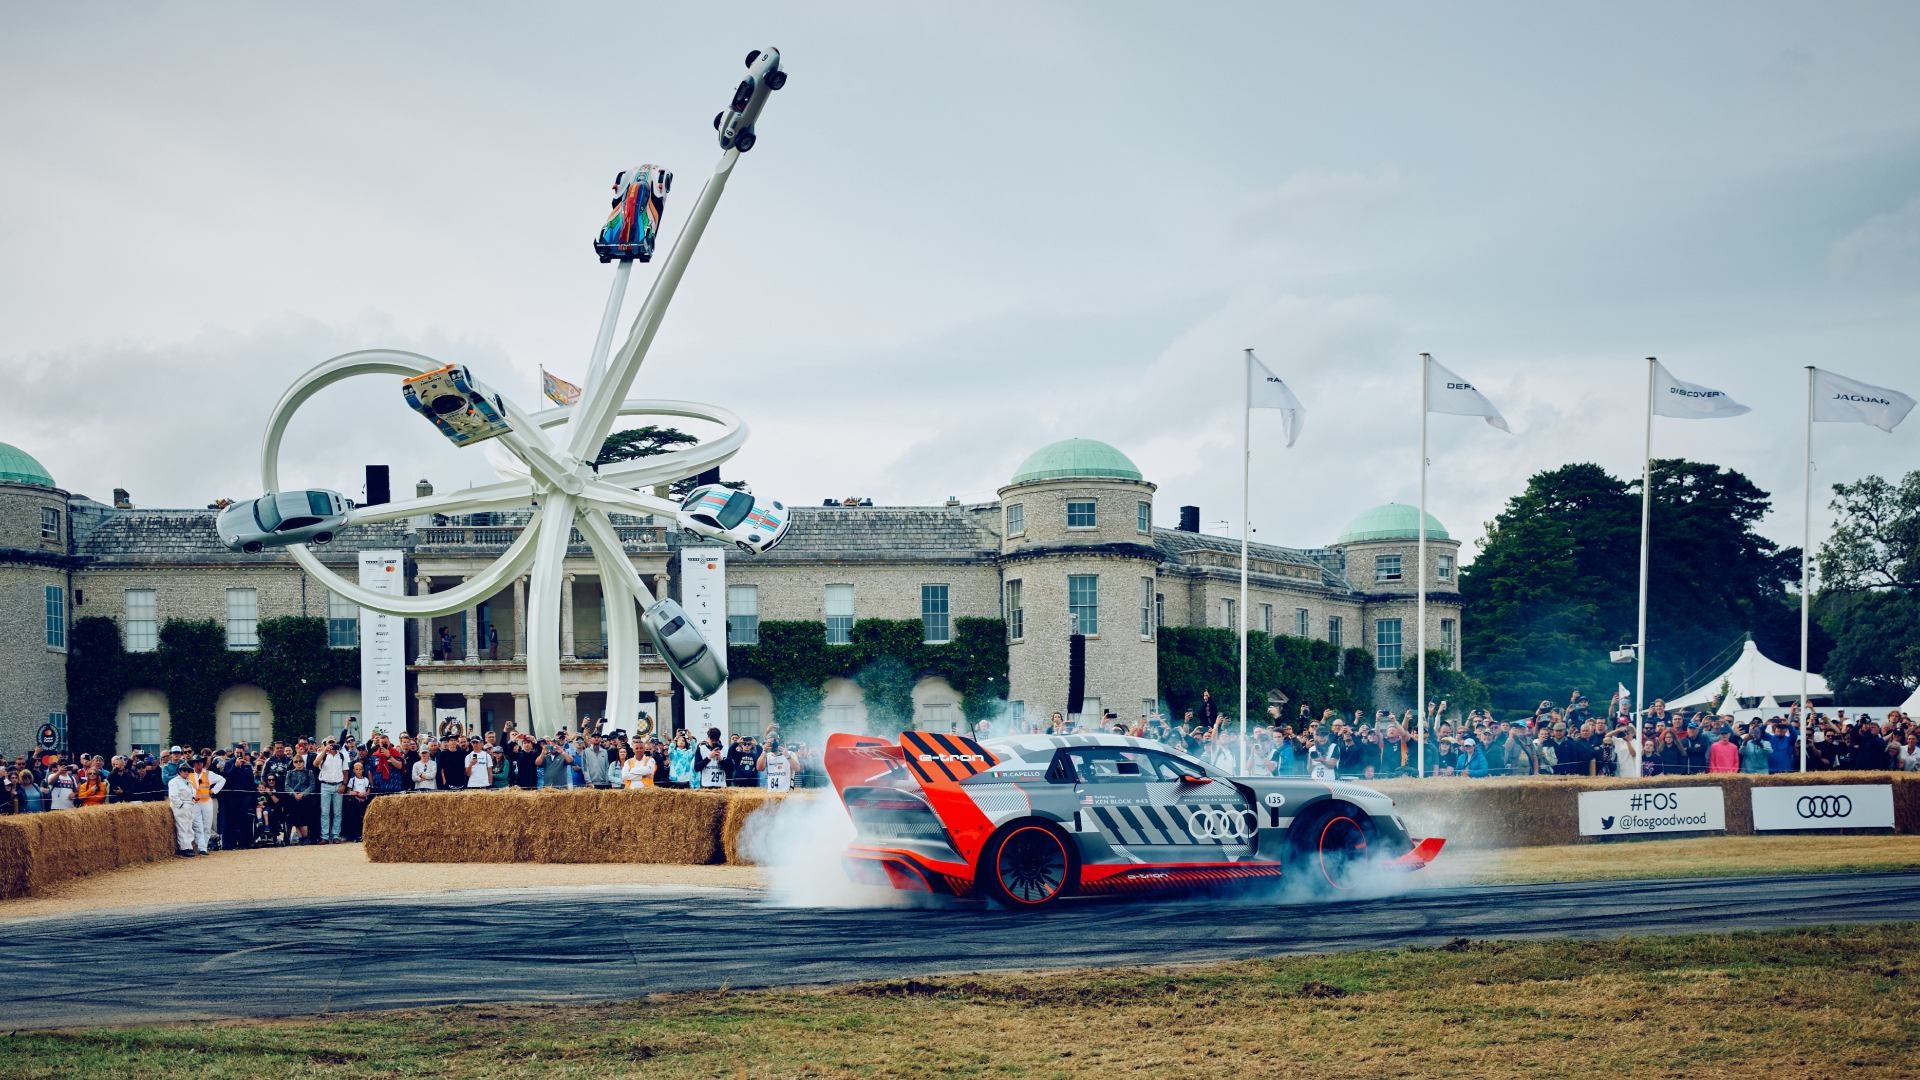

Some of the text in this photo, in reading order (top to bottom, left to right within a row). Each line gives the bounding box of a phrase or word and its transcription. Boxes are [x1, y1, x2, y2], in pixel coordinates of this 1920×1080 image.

[1447, 382, 1476, 391] DEF
[1832, 393, 1890, 405] JAGUAR
[919, 753, 985, 762] e-tron
[770, 777, 779, 789] 84
[1268, 796, 1281, 804] 135
[1630, 792, 1678, 811] #FOS
[1619, 812, 1707, 830] @fosgoodwood
